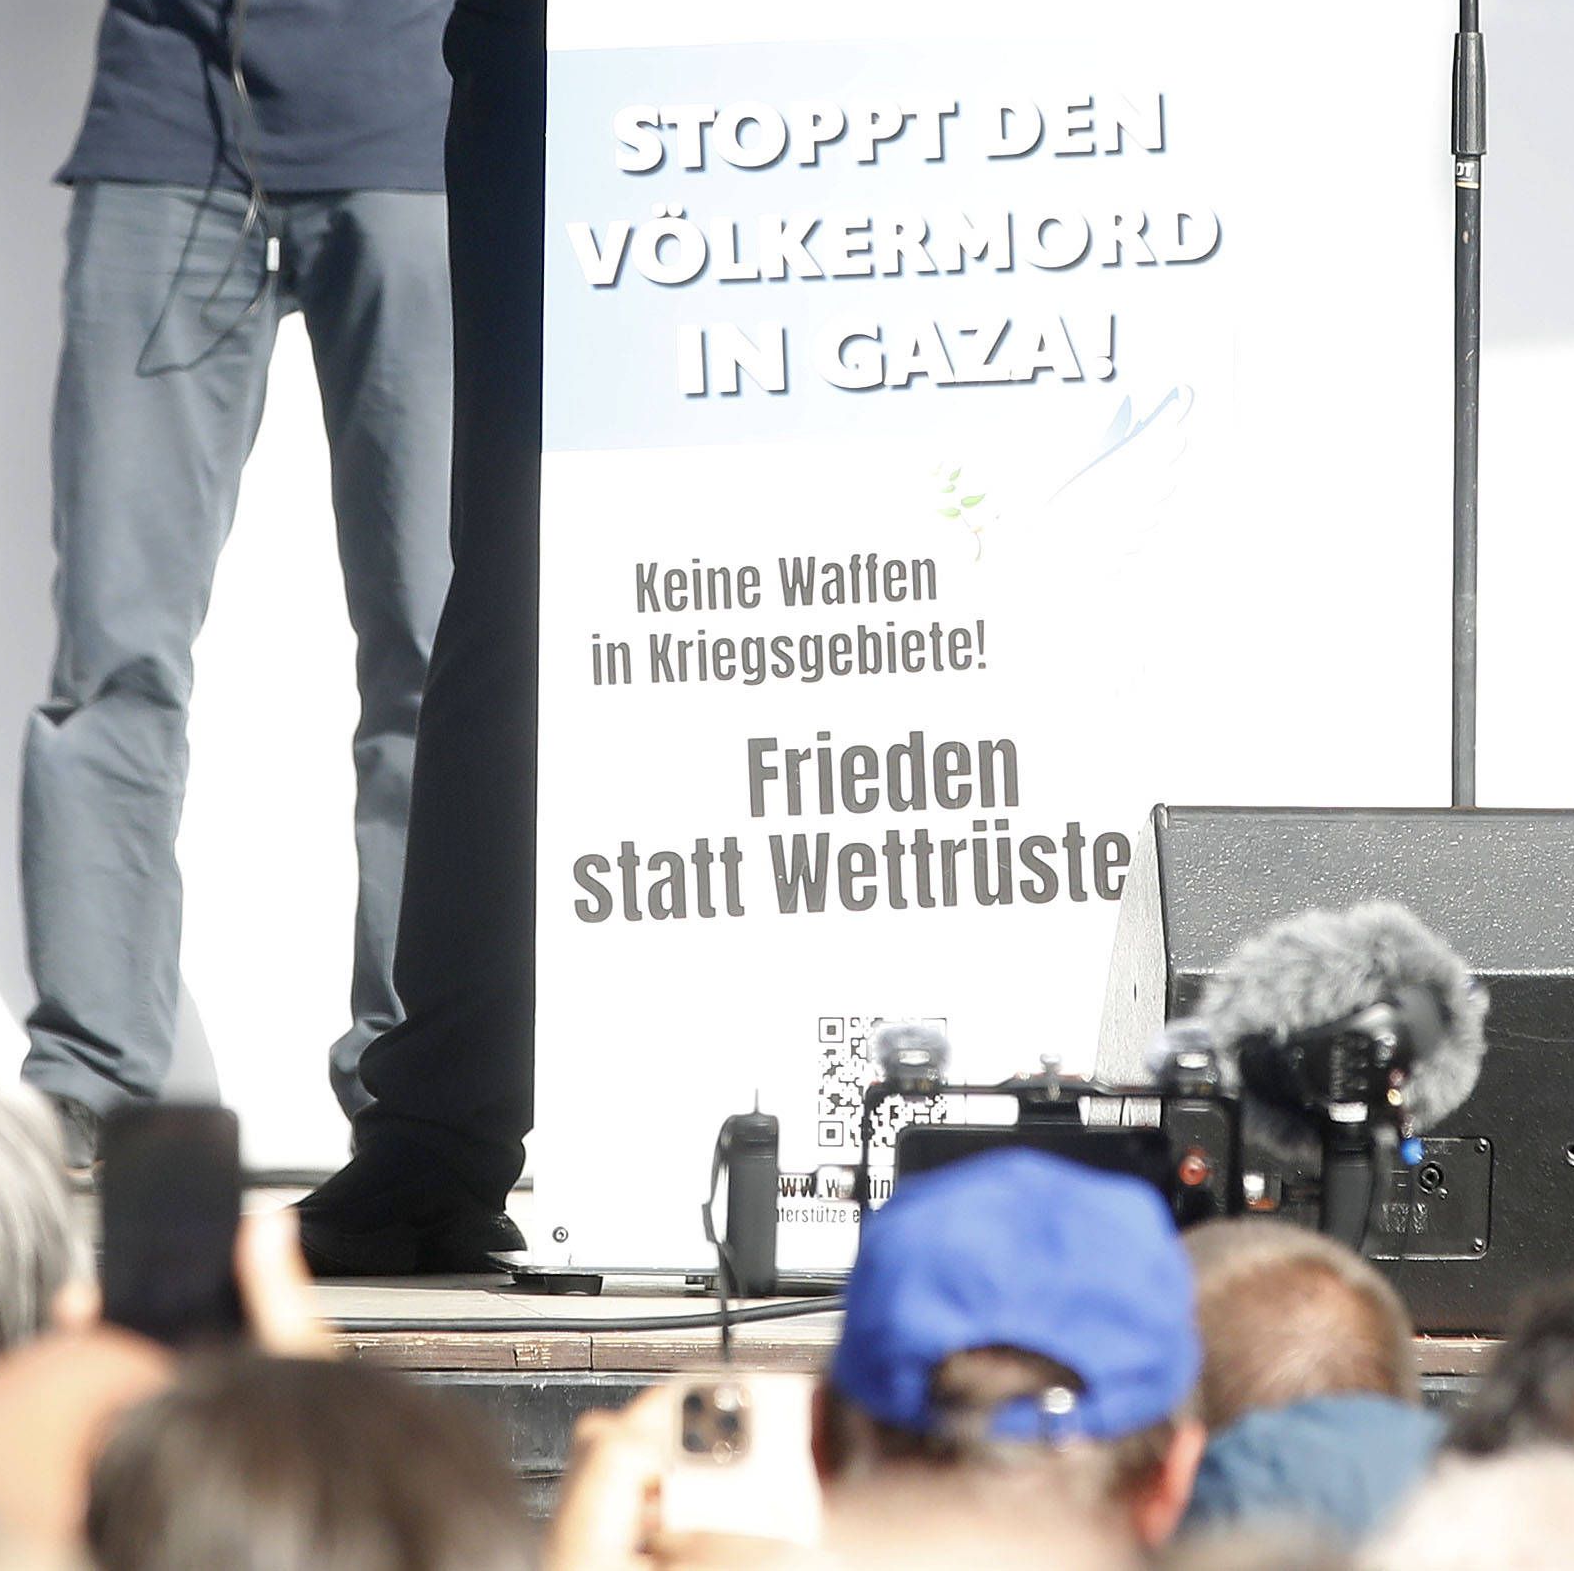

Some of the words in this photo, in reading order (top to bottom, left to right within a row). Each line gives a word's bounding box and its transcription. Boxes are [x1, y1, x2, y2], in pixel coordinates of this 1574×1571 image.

[612, 99, 960, 177] STOPPT
[987, 89, 1167, 162] DEN
[565, 202, 1223, 290] VÖLKERMORD
[675, 321, 790, 399] IN
[819, 313, 1118, 393] GAZA!
[635, 558, 761, 613] Keine
[778, 553, 937, 607] Waffen
[591, 633, 632, 686] in
[649, 619, 987, 686] Kriegsgebiete!
[747, 730, 1020, 818] Frieden
[572, 836, 745, 923] statt
[768, 819, 1131, 915] Wettrüste
